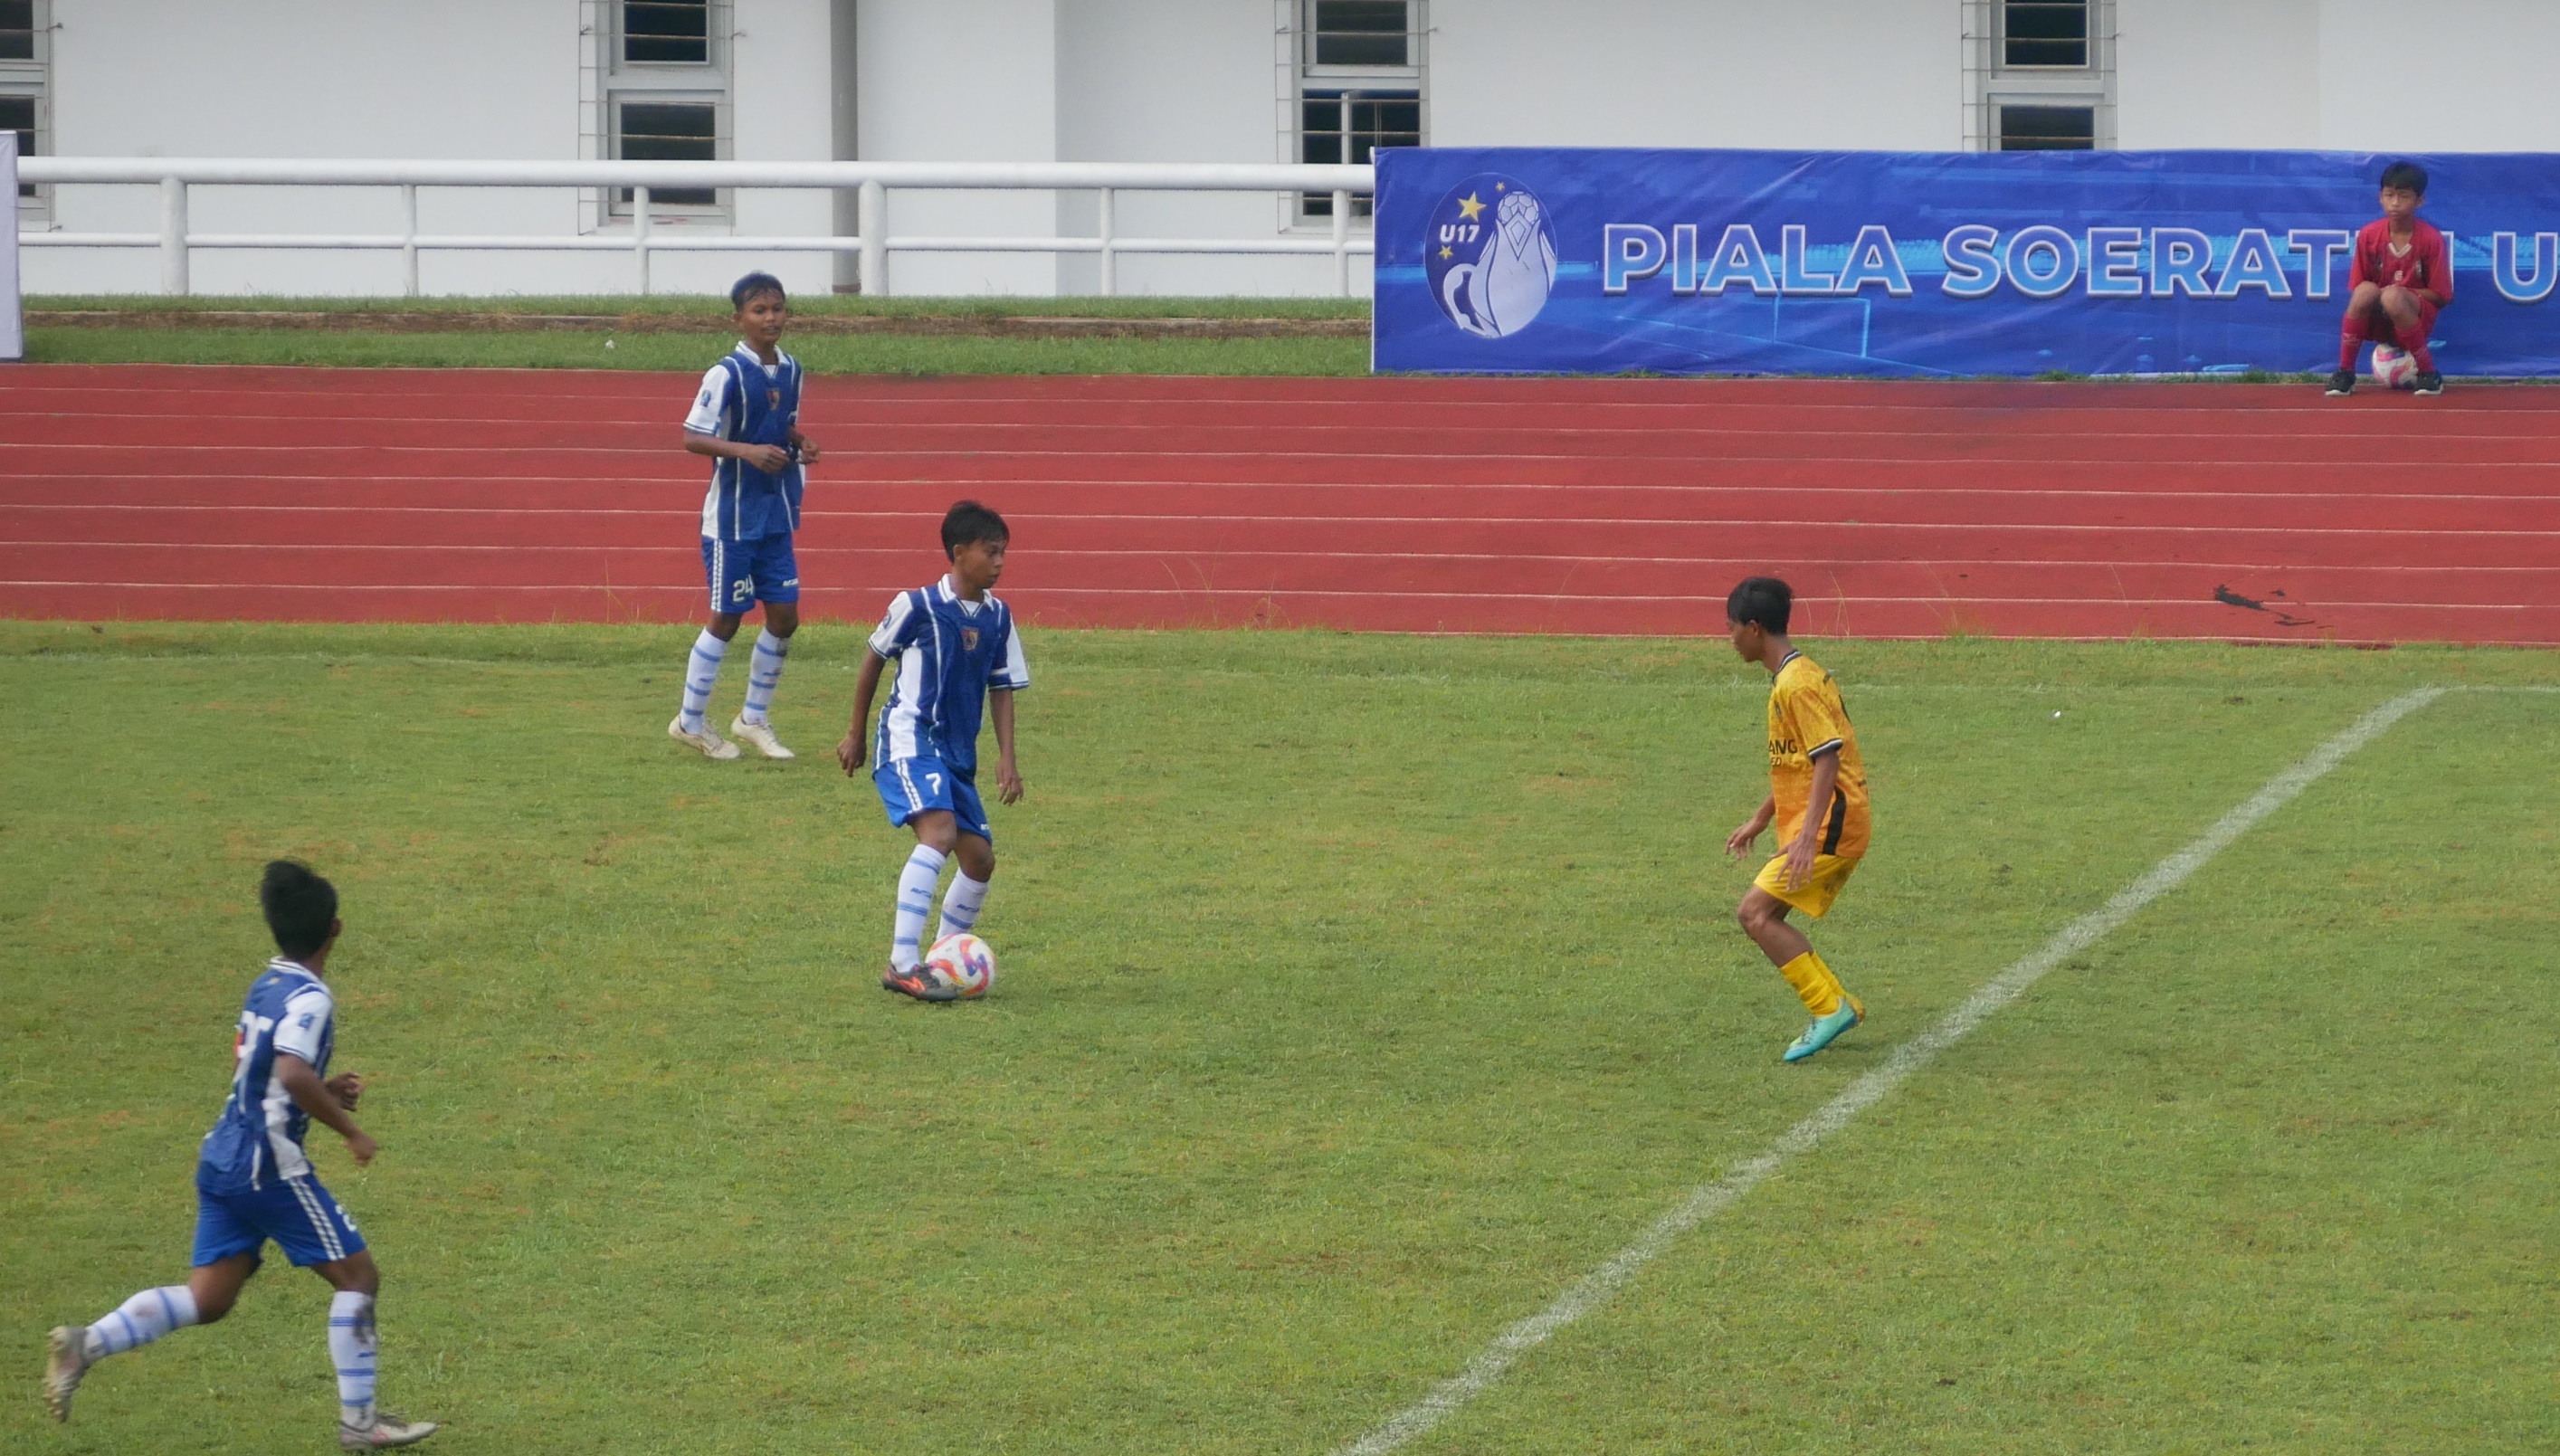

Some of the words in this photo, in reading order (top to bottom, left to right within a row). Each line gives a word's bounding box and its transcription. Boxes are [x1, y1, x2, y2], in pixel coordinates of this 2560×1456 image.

[1439, 224, 1480, 243] U17
[1604, 224, 1914, 297] PIALA
[732, 574, 755, 602] 24
[925, 772, 941, 795] 7
